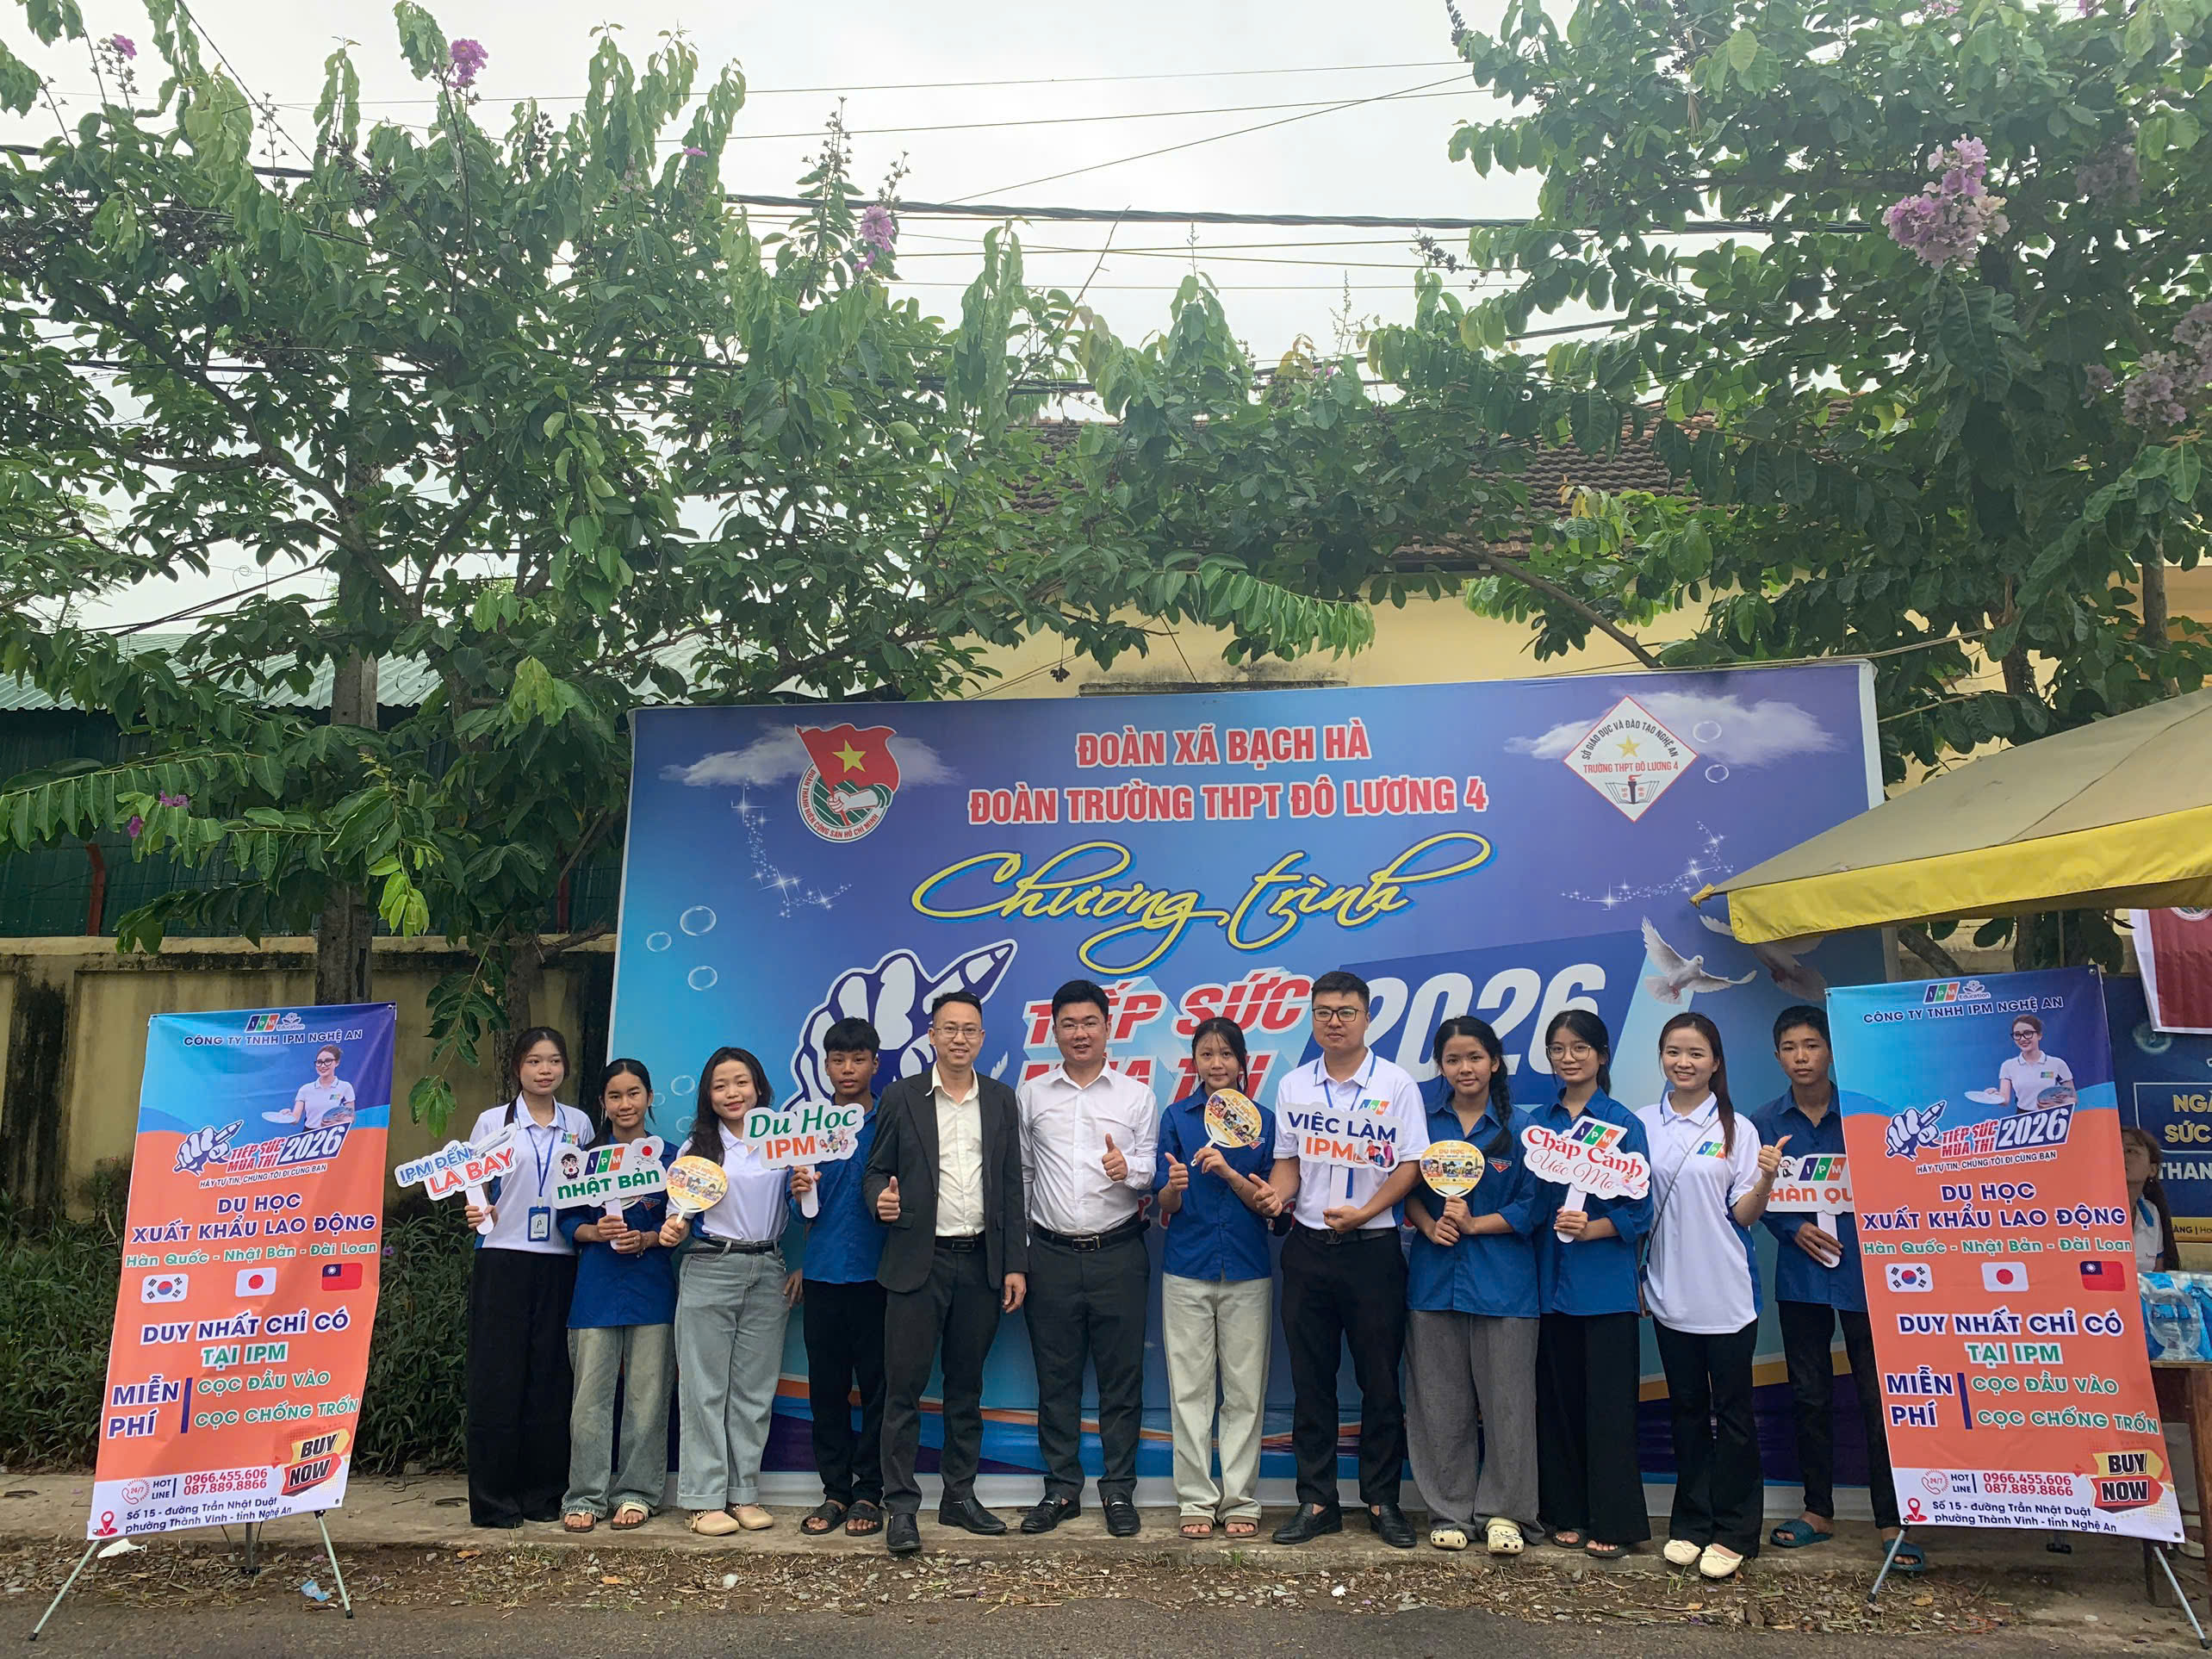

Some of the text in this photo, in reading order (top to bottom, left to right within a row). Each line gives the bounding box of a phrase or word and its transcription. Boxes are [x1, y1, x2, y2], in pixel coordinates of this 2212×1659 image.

[1077, 718, 1372, 770] ĐOÀN XÃ BẠCH HÀ
[1598, 725, 1613, 737] DỤC
[1613, 719, 1625, 730] VÀ
[1625, 718, 1640, 729] ĐÀO
[1668, 745, 1679, 757] AN
[1614, 763, 1634, 772] THPT
[1673, 761, 1678, 770] 4
[969, 775, 1488, 824] ĐOÀN TRƯỜNG THPT ĐÔ LƯƠNG 4
[863, 814, 879, 830] MINH
[910, 831, 1493, 975] Chương trình
[1173, 966, 1314, 1038] SỨC
[1863, 997, 2065, 1025] CÔNG TY TNHH IPM NGHỆ AN
[183, 1029, 363, 1047] CÔNG TY TNHH IPM NGHỆ AN
[749, 1105, 857, 1139] Du Học
[1288, 1111, 1397, 1144] VIỆC LÀM
[1998, 1109, 2069, 1147] 2026
[2165, 1121, 2212, 1143] SỨC
[280, 1125, 345, 1164] 2026
[766, 1135, 816, 1160] IPM
[1305, 1136, 1353, 1161] IPM
[1528, 1128, 1643, 1177] Chắp Cánh
[1973, 1138, 1995, 1153] THI
[258, 1153, 279, 1169] THI
[400, 1143, 471, 1183] IPM ĐẾN
[429, 1146, 514, 1195] LÀ BAY
[1947, 1162, 1960, 1171] TIN,
[218, 1194, 301, 1214] DU HỌC
[1941, 1182, 2036, 1204] DU HỌC
[132, 1213, 376, 1244] XUẤT KHẨU LAO ĐỘNG
[1862, 1203, 2127, 1230] XUẤT KHẨU LAO ĐỘNG
[126, 1243, 376, 1267] Hàn Quốc Nhật Bản Đài Loan
[1862, 1238, 2133, 1256] Hàn Quốc Nhật Bản Đài Loan
[141, 1307, 349, 1345] DUY NHẤT CHỈ CÓ
[1897, 1306, 2124, 1337] DUY NHẤT CHỈ CÓ
[202, 1342, 289, 1370] TẠI IPM
[1965, 1343, 2063, 1369] TẠI IPM
[112, 1375, 180, 1407] MIỄN
[197, 1369, 331, 1396] CỌC ĐẦU VÀO
[1885, 1365, 1954, 1395] MIỄN
[1972, 1371, 2118, 1395] CỌC ĐẦU VÀO
[107, 1408, 158, 1438] PHÍ
[195, 1395, 359, 1429] CỌC CHỐNG TRỐN
[1890, 1399, 1938, 1427] PHÍ
[1977, 1407, 2159, 1435] CỌC CHỐNG TRỐN
[300, 1432, 339, 1460] BUY
[184, 1469, 268, 1485] 0966.455.606
[289, 1459, 331, 1488] NOW
[2108, 1453, 2148, 1475] BUY
[183, 1479, 267, 1496] 087.889.8866
[1983, 1472, 2072, 1486] 0966.455.606
[1984, 1483, 2073, 1496] 087.889.8866
[2101, 1481, 2148, 1503] NOW
[127, 1496, 277, 1520] Số 15 đường Trần Nhật Duật
[152, 1491, 170, 1500] LINE
[1933, 1501, 1945, 1509] Số
[1971, 1502, 2005, 1513] đường
[2008, 1503, 2032, 1513] Trần
[2035, 1505, 2060, 1515] Nhật
[2065, 1507, 2091, 1517] Duật
[125, 1506, 291, 1534] phường Thành Vinh Nghệ An
[1935, 1514, 2117, 1532] phường Thành Vinh Nghệ An
